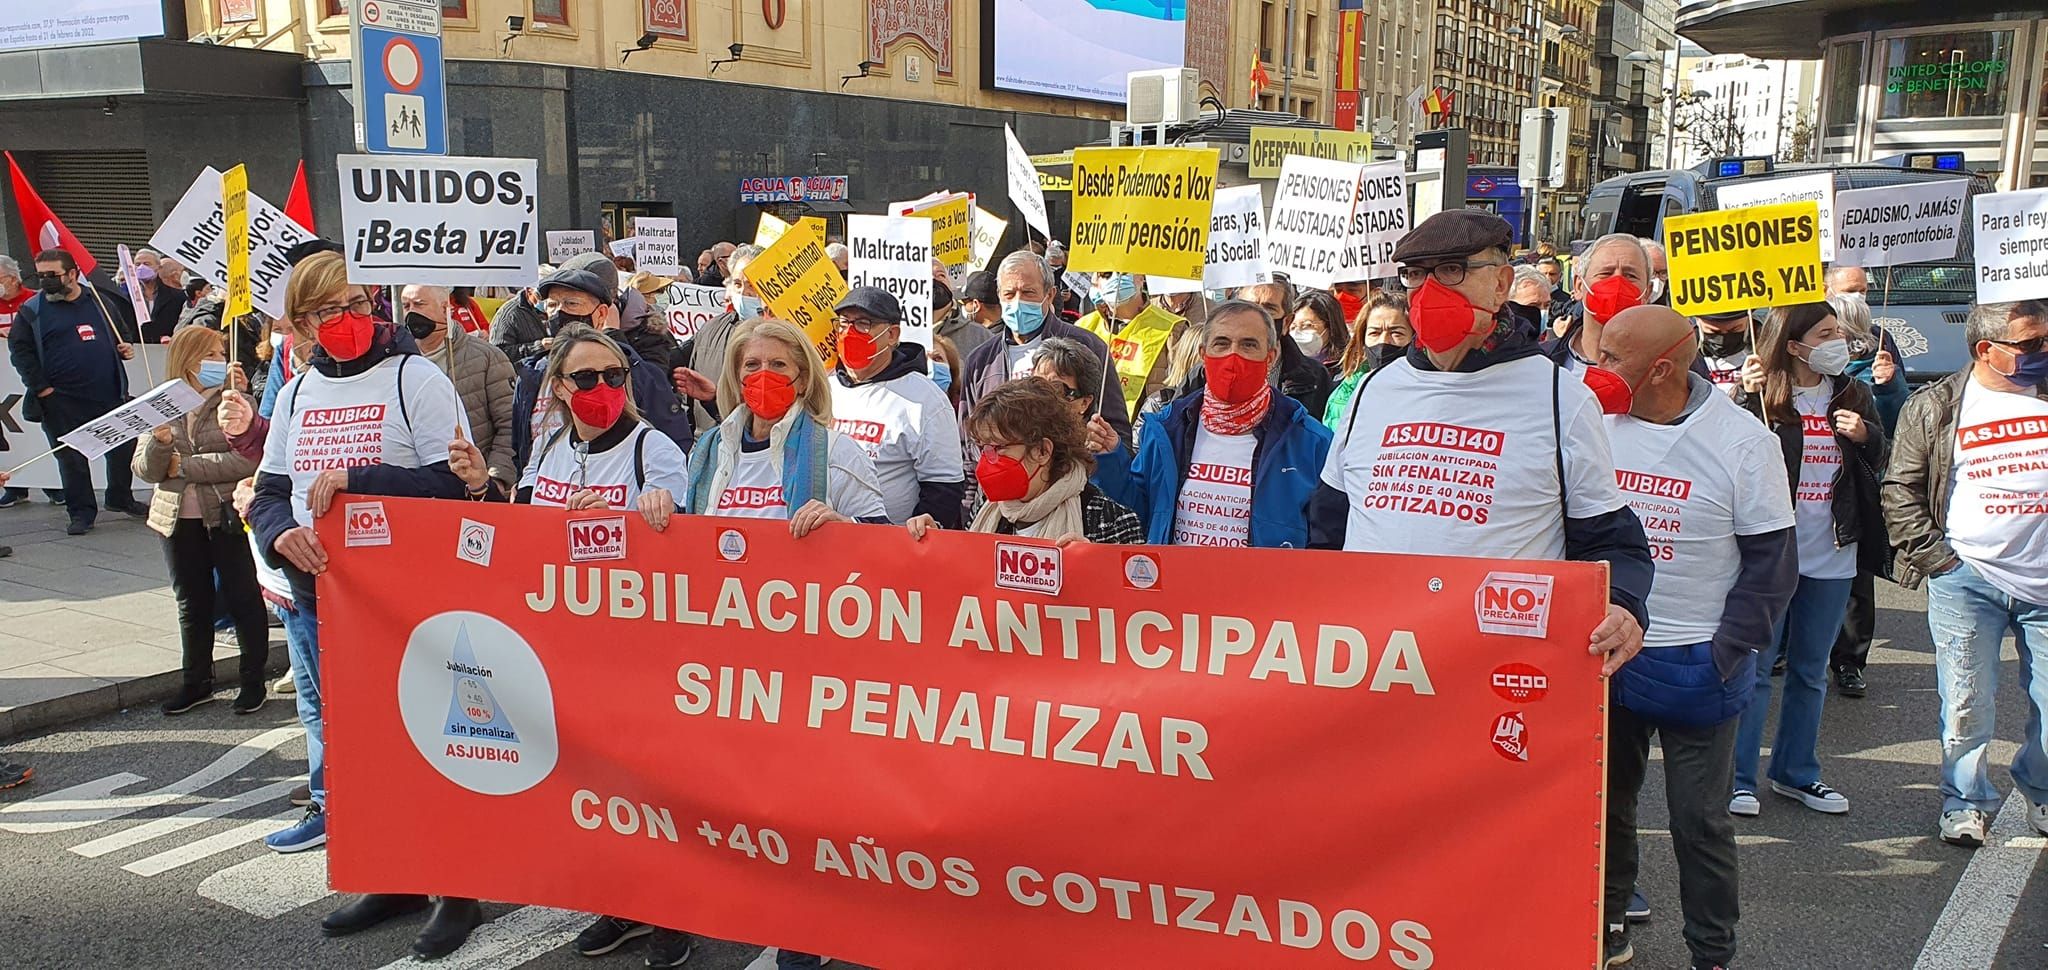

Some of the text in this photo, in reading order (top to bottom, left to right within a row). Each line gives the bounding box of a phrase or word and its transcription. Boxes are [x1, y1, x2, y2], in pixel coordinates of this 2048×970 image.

[1889, 60, 2006, 78] UNITED COLORS
[1887, 80, 1904, 93] OF
[352, 168, 534, 214] UNIDOS,
[741, 178, 786, 192] AGUA
[806, 177, 831, 191] AGUA
[1078, 165, 1114, 197] Desde
[1116, 165, 1171, 199] Podemos
[1174, 173, 1182, 199] a
[1187, 166, 1212, 201] Vox
[1280, 173, 1353, 203] ¡PENSIONES
[1357, 175, 1401, 202] SIONES
[741, 192, 789, 202] FRIA
[1780, 190, 1824, 204] Gobiernos
[953, 209, 966, 226] Vox
[1210, 211, 1261, 233] aras, ya,
[1275, 208, 1345, 238] AJUSTADAS
[1841, 196, 1962, 229] ¡EDADISMO, JAMÁS!
[1982, 210, 2048, 232] Para el rey
[354, 220, 530, 263] ¡Basta ya!
[638, 227, 676, 238] Maltratar
[1076, 213, 1204, 254] exijo mi pensión.
[1670, 215, 1813, 257] PENSIONES
[1839, 224, 1956, 251] No a la gerontofobia.
[638, 242, 645, 251] al
[648, 243, 676, 254] mayor,
[853, 237, 929, 263] Maltratar
[1205, 238, 1260, 264] ad Social!
[1268, 242, 1306, 269] CON EL
[1361, 245, 1376, 266] EL
[639, 254, 676, 267] ¡JAMÁS!
[756, 240, 824, 303] Nos discriminan
[853, 270, 930, 299] al mayor,
[1675, 264, 1817, 305] JUSTAS, YA!
[1982, 265, 2010, 284] Para
[788, 304, 813, 329] los
[900, 301, 928, 327] ÁS!
[305, 406, 380, 425] ASJUBI40
[297, 432, 382, 447] SIN PENALIZAR
[300, 423, 382, 435] JUBILACIÓN ANTICIPADA
[1386, 425, 1498, 451] ASJUBI40
[1962, 419, 2048, 446] ASJUBI
[295, 445, 382, 457] CON MÁS DE 40 AÑOS
[1377, 451, 1497, 471] JUBILACIÓN ANTICIPADA
[1188, 463, 1251, 484] SJUBI4
[1372, 464, 1495, 490] SIN PENALIZAR
[1967, 461, 2048, 480] SIN PENAL
[1368, 480, 1493, 505] CON MÁS DE 40 AÑOS
[1617, 472, 1685, 498] JUBI40
[1177, 500, 1251, 519] N PENALIZA
[1364, 495, 1489, 525] COTIZADOS
[1629, 500, 1680, 516] ANTICIPADA
[1985, 504, 2048, 515] COTIZA
[1187, 519, 1249, 534] MÁS DE 40 AÑO
[1644, 516, 1680, 533] IZAR
[573, 525, 622, 548] NO+
[574, 545, 621, 554] PRECARIEDA
[1648, 544, 1673, 560] OS
[1001, 550, 1056, 576] NO+
[1000, 573, 1055, 587] PRECARIEDAD
[525, 564, 1436, 696] JUBILACIÓN ANTICIPADA
[446, 661, 492, 678] Jubilación
[1493, 673, 1547, 689] CCOO
[451, 723, 515, 739] sin penalizar
[674, 663, 1213, 781] SIN PENALIZAR
[446, 743, 519, 763] ASJUBI40
[571, 789, 1435, 970] CON +40 AÑOS COTIZADOS
